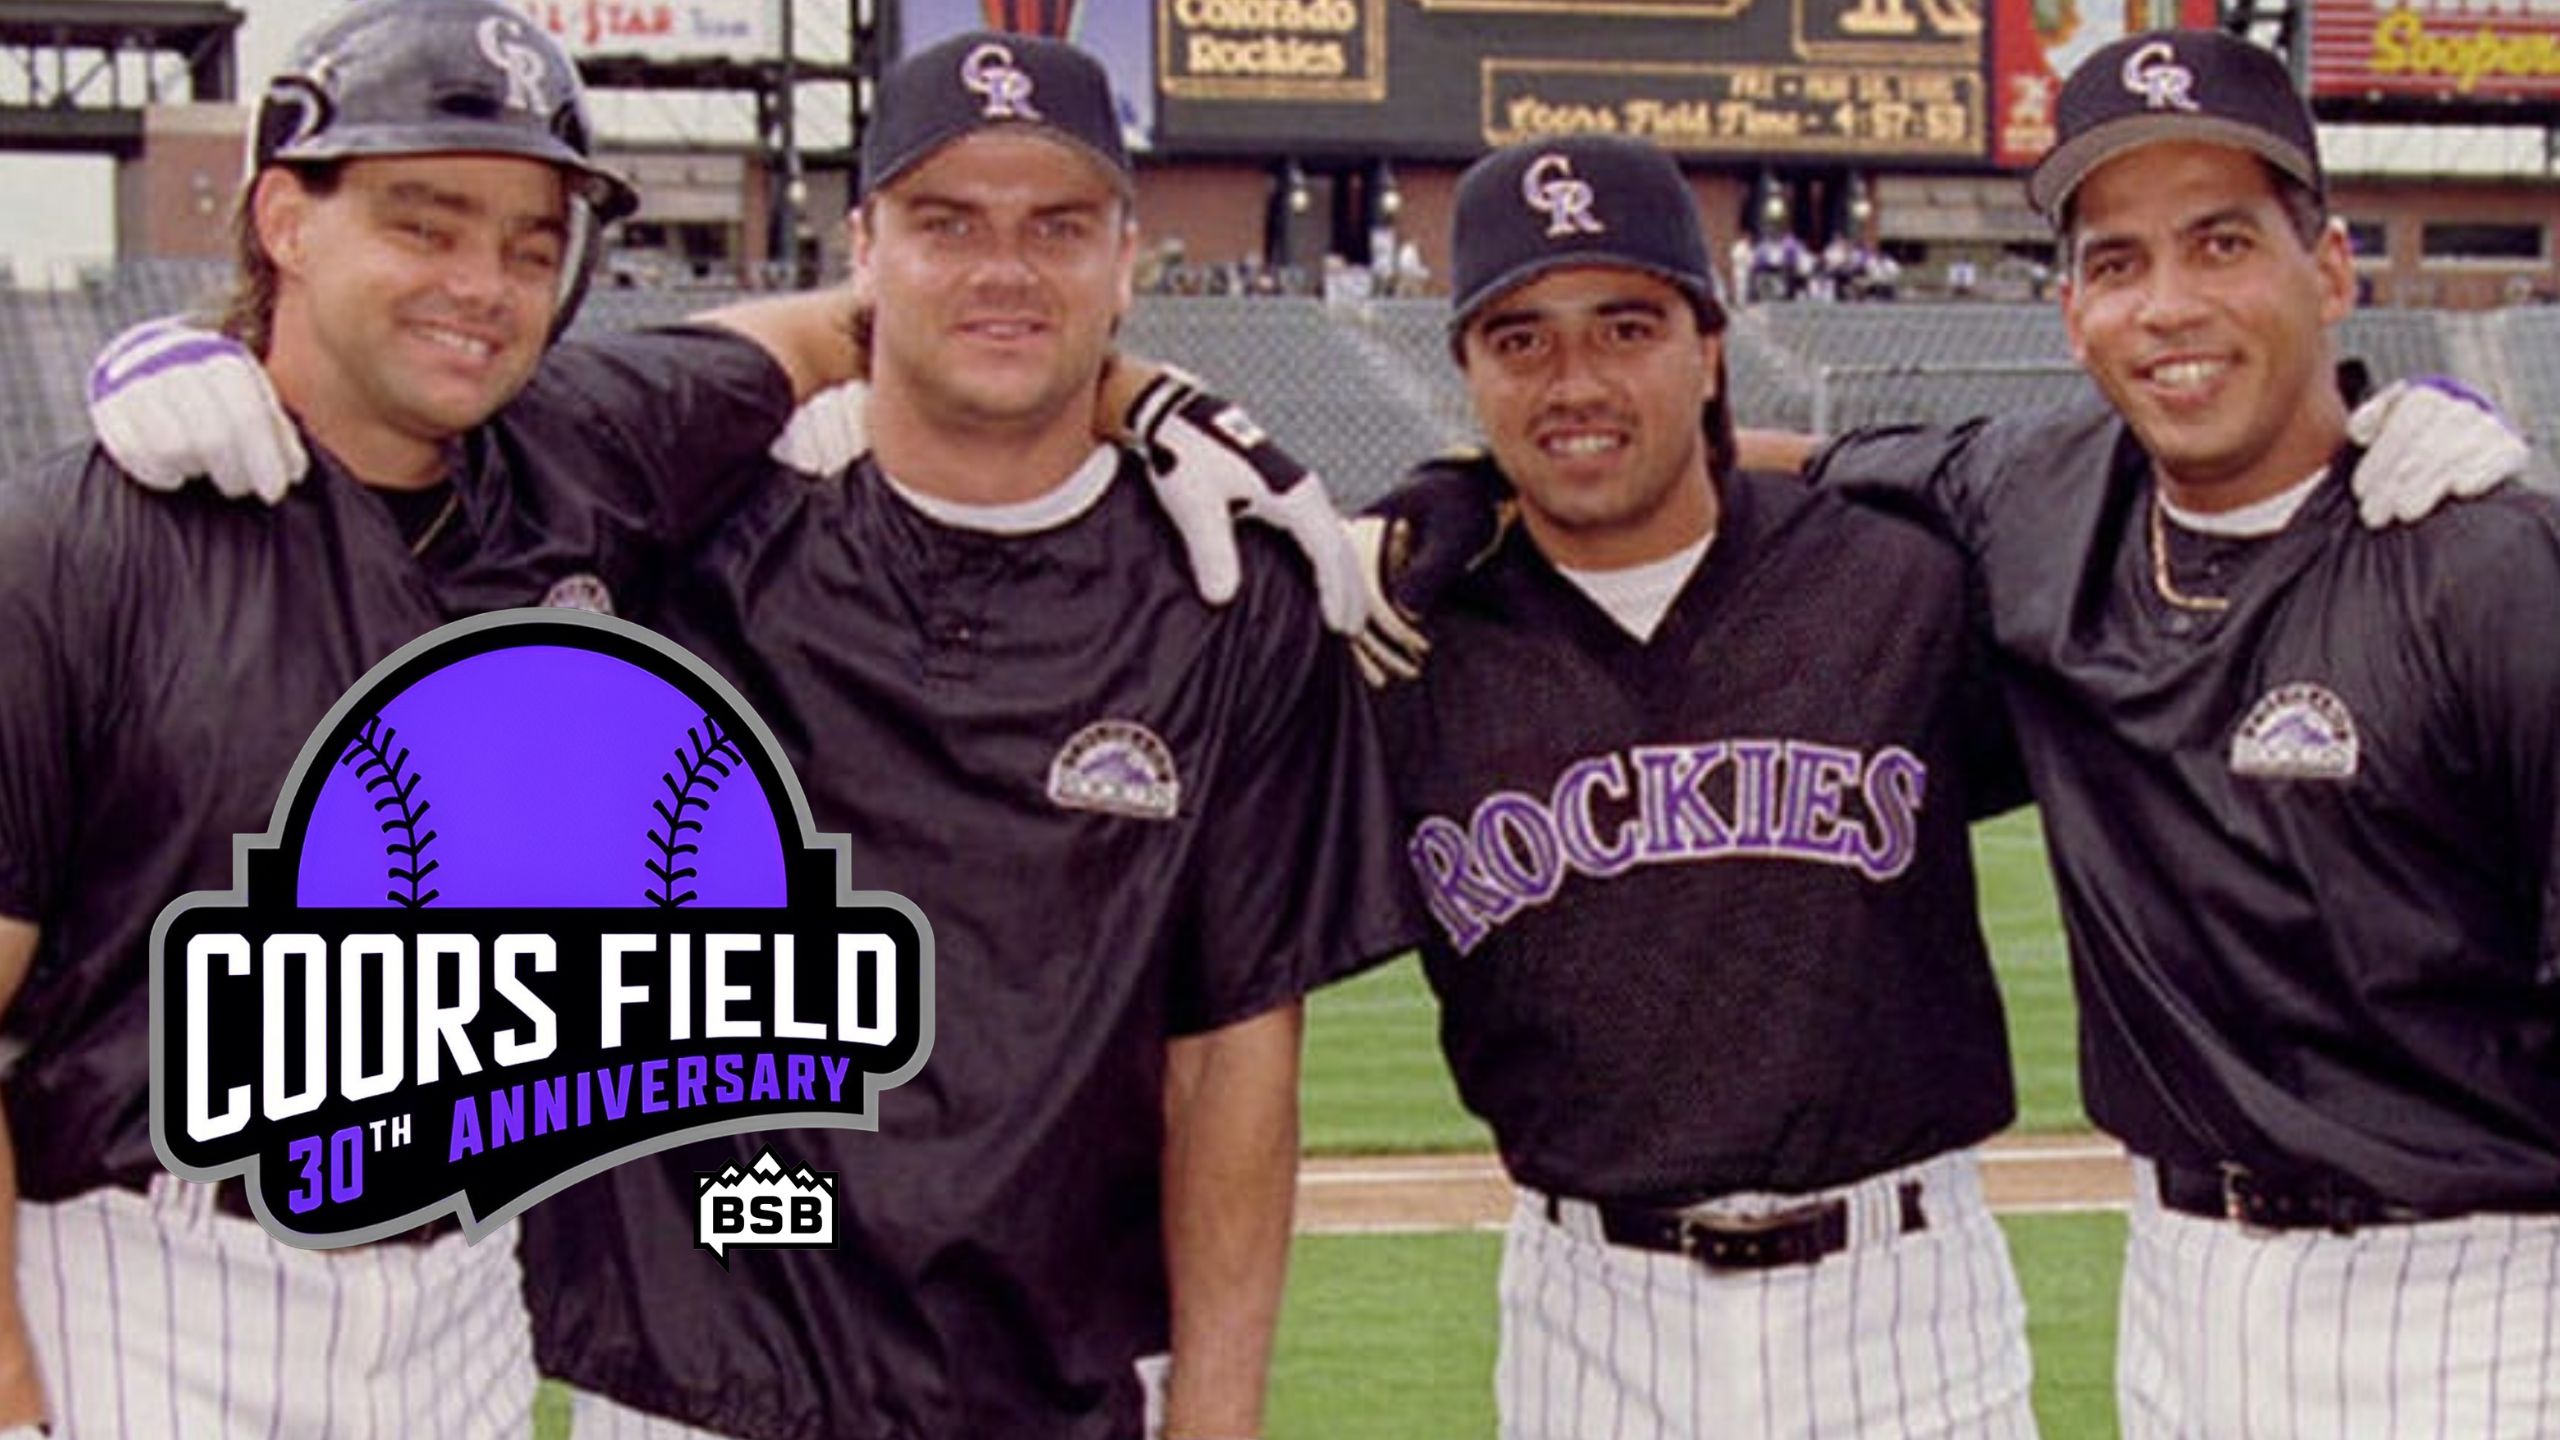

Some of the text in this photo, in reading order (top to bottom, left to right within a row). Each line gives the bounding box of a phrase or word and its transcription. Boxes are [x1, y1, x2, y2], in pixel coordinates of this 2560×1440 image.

[961, 43, 1041, 120] CR
[1189, 35, 1346, 74] Rockies
[2122, 42, 2199, 111] CR
[1521, 154, 1604, 237] CR
[1409, 741, 1927, 956] ROCKIES
